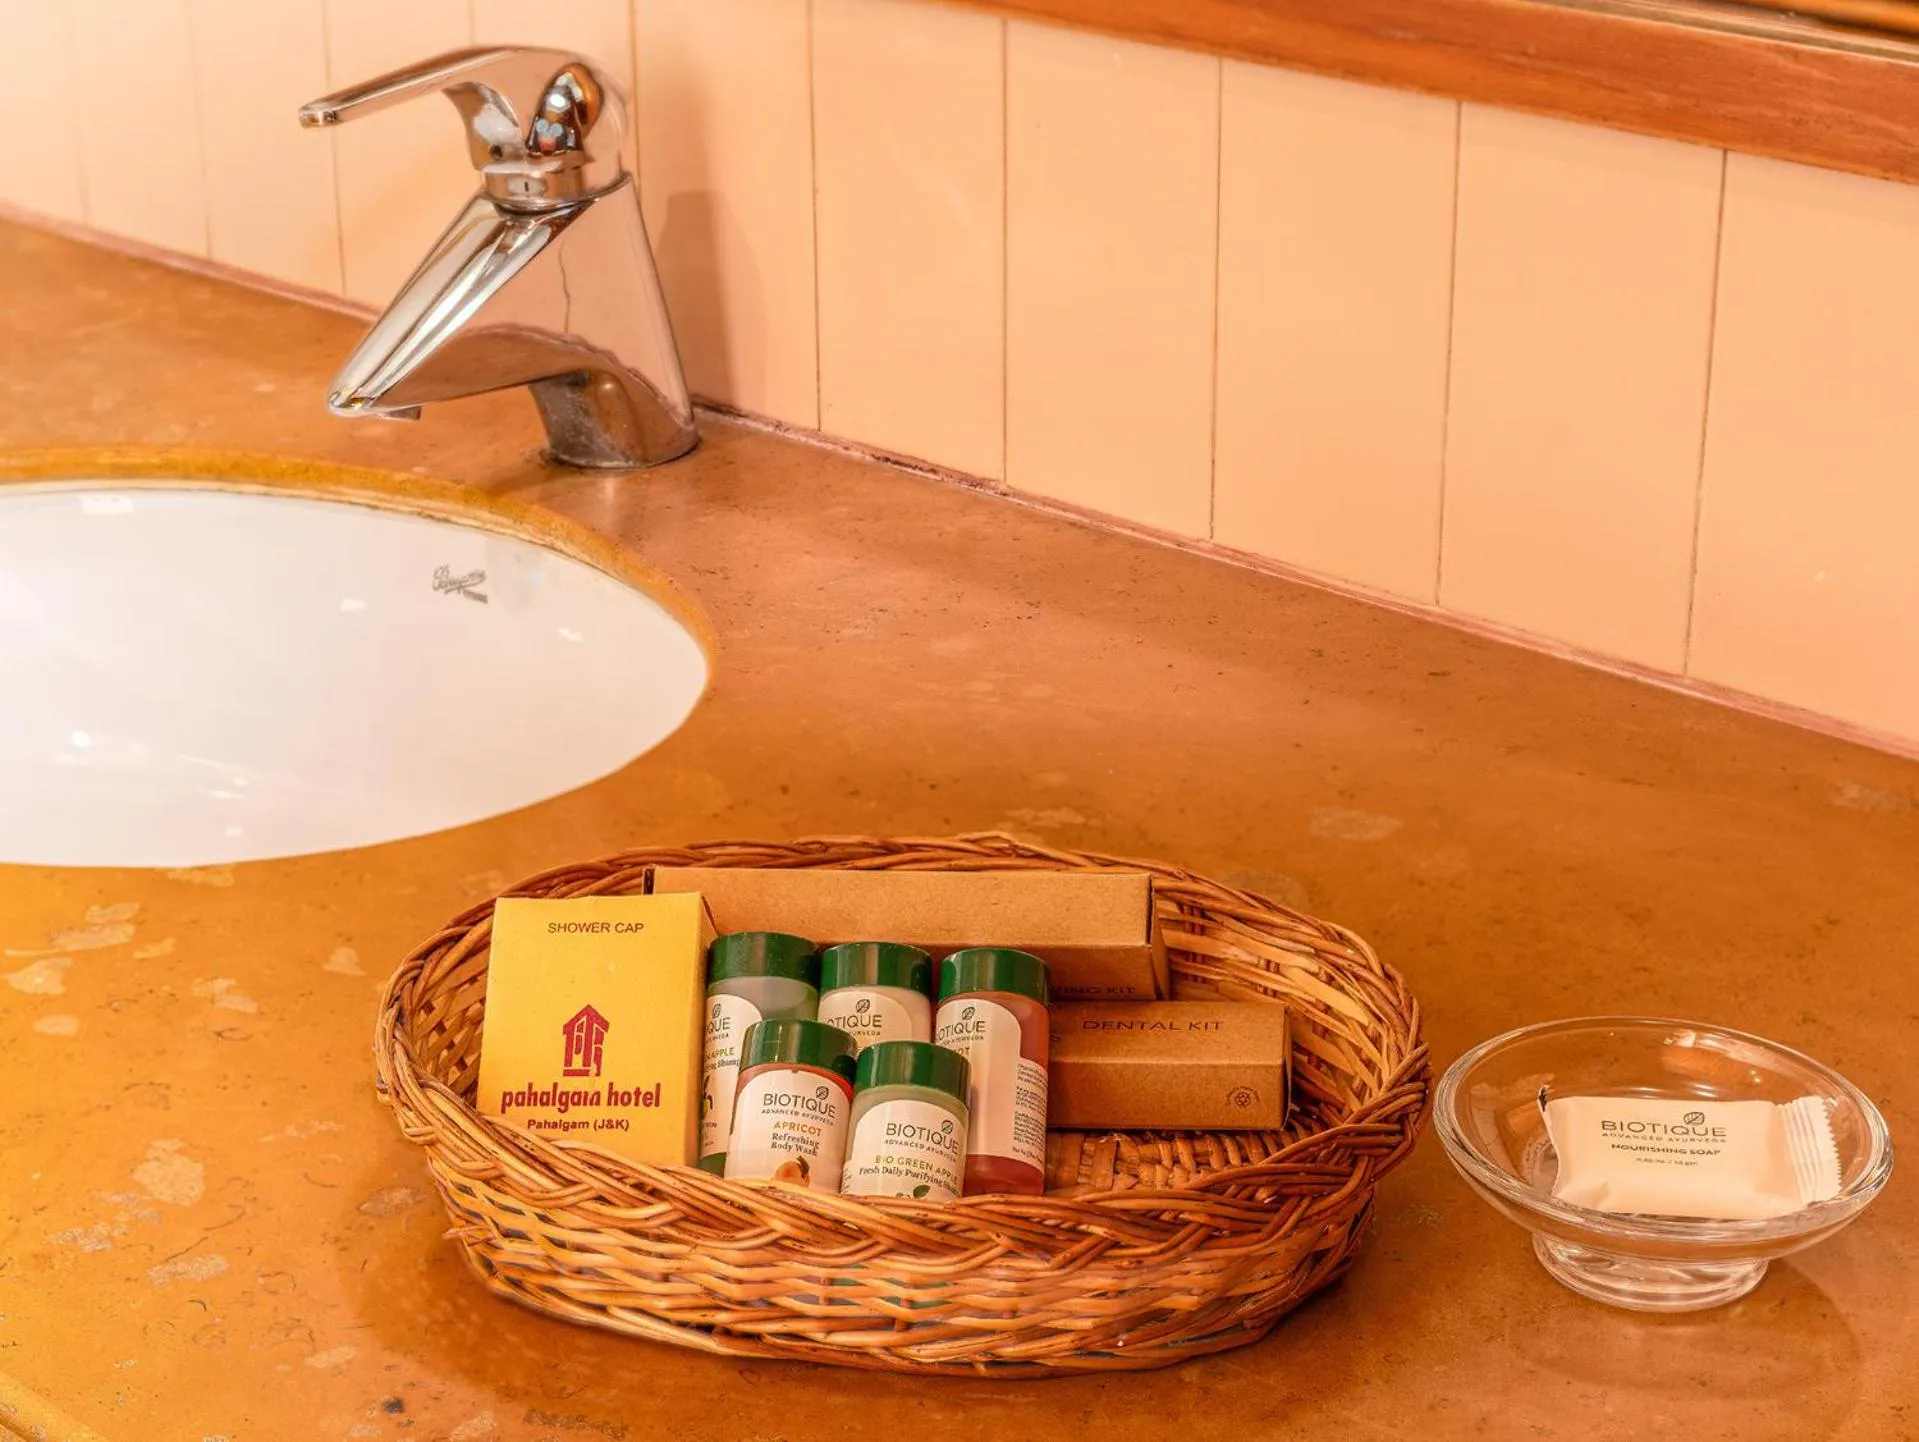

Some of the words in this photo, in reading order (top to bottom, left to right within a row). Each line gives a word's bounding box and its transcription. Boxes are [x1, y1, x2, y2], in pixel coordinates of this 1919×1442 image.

[548, 922, 610, 933] SHOWER
[614, 922, 644, 933] CAP
[1082, 1020, 1184, 1031] DENTAL
[1188, 1020, 1225, 1031] KIT
[501, 1082, 601, 1114] pahalgam
[607, 1082, 661, 1107] hotel
[763, 1093, 836, 1118] BIOTIQUE
[528, 1119, 589, 1131] Pahalgam
[593, 1119, 629, 1132] (J&K)
[774, 1121, 822, 1136] APRICOT
[1601, 1120, 1727, 1137] BIOTIQUE
[772, 1132, 820, 1149] Refreshing
[886, 1122, 960, 1155] BIOTIQUE
[1602, 1132, 1662, 1141] ADVANCED
[771, 1141, 793, 1151] Body
[795, 1144, 818, 1157] Wash
[1611, 1143, 1687, 1154] NOURISHING
[859, 1165, 880, 1175] Fresh
[882, 1167, 904, 1178] Daily
[905, 1169, 943, 1188] Purifying
[875, 1155, 894, 1164] BIO
[897, 1157, 933, 1171] GREEN
[935, 1167, 958, 1185] APPLE
